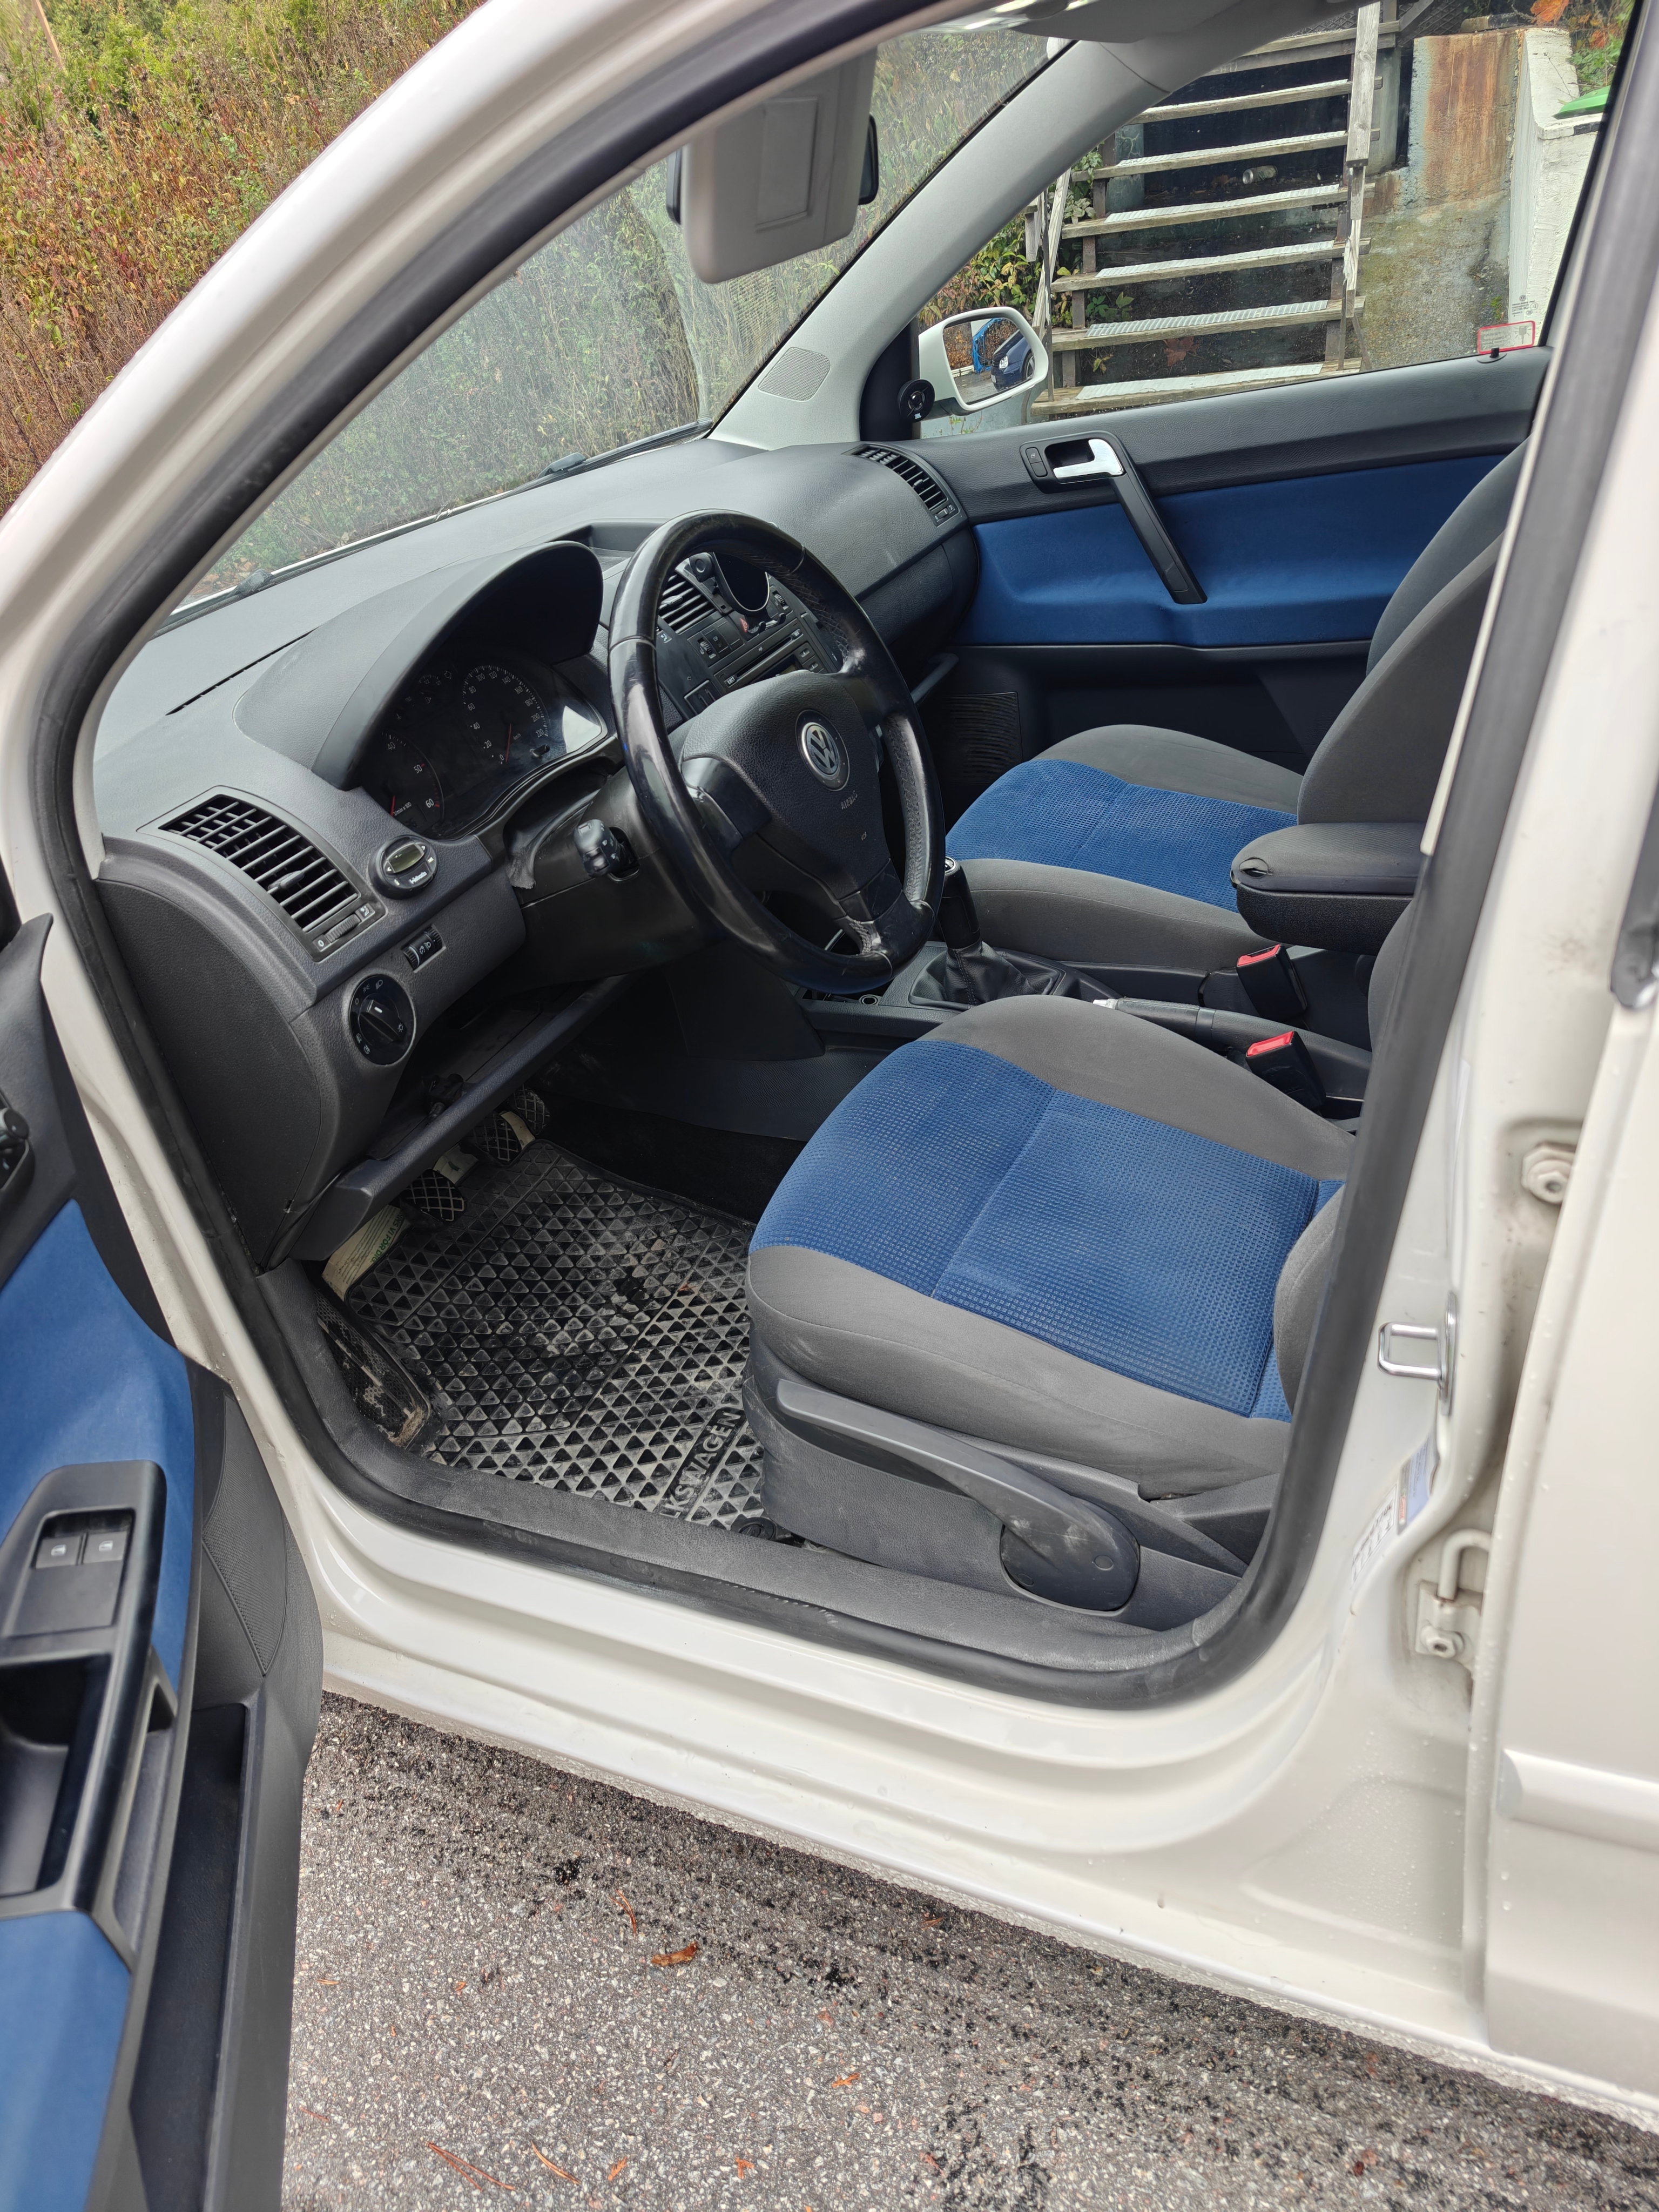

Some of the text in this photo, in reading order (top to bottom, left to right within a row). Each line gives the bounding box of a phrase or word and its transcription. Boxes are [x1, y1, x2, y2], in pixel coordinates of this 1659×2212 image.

[476, 673, 485, 682] 100
[489, 671, 497, 679] 120
[502, 676, 511, 685] 140
[469, 685, 476, 694] 80
[514, 685, 523, 694] 160
[524, 698, 533, 706] 180
[468, 703, 475, 711] 60
[531, 713, 541, 722] 200
[473, 722, 481, 730] 40
[536, 729, 544, 738] 220
[387, 741, 396, 750] 40
[484, 740, 492, 748] 20
[413, 764, 422, 774] 50
[426, 798, 434, 808] 60
[841, 790, 858, 810] AIRBAG
[388, 1227, 396, 1236] VI
[379, 1234, 392, 1251] FÖR
[659, 1411, 741, 1518] LKSWAGEN
